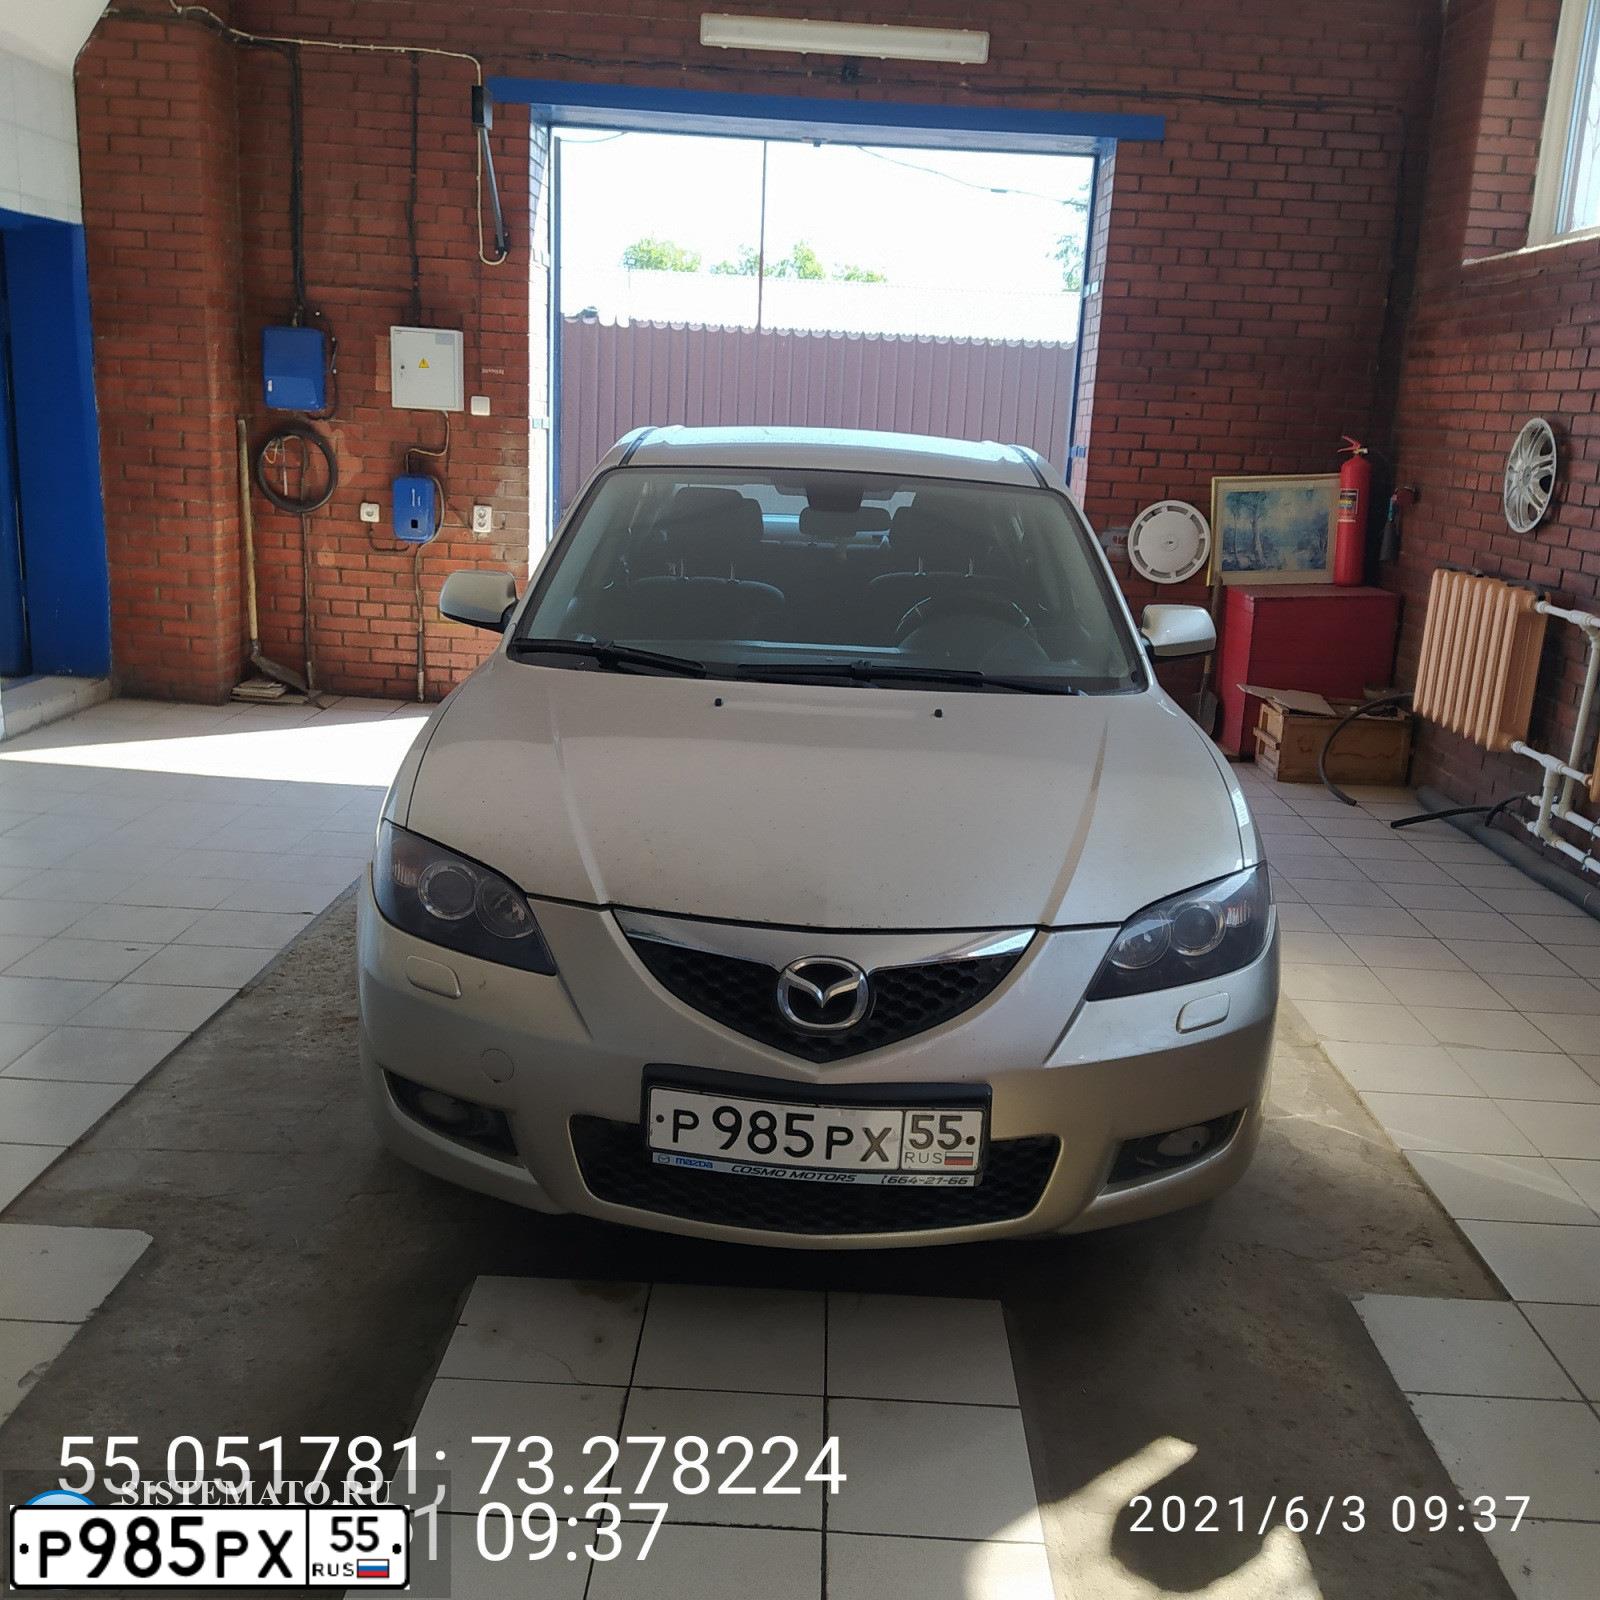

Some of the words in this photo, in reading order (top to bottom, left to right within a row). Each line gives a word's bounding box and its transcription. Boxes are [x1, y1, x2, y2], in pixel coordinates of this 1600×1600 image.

[909, 1114, 963, 1150] 55
[675, 1157, 714, 1169] mazda
[730, 1164, 787, 1178] COSMO
[788, 1171, 857, 1183] MOTORS
[904, 1151, 943, 1164] RUS
